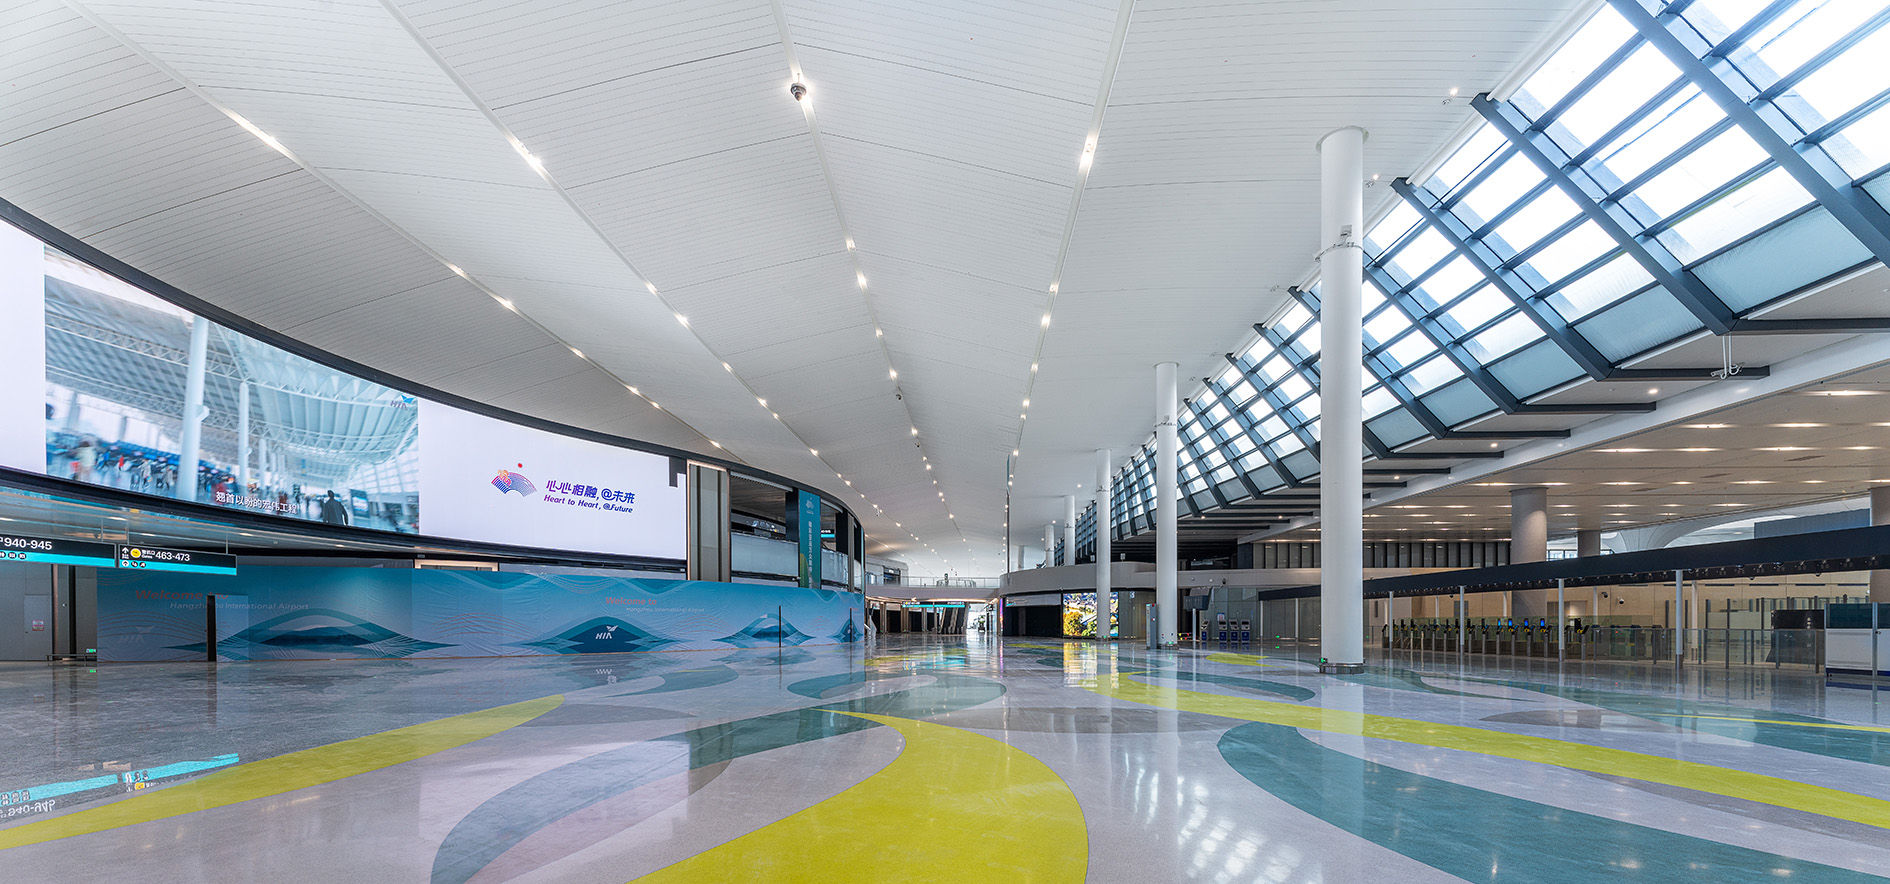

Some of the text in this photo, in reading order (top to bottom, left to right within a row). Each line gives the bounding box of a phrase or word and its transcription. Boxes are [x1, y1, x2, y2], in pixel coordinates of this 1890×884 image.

[543, 494, 565, 505] Heart
[567, 497, 576, 506] to
[4, 537, 53, 551] 940-945
[155, 551, 191, 562] 463-473
[135, 590, 203, 600] Welcome
[606, 597, 657, 606] Welcome to
[595, 632, 612, 640] HIA
